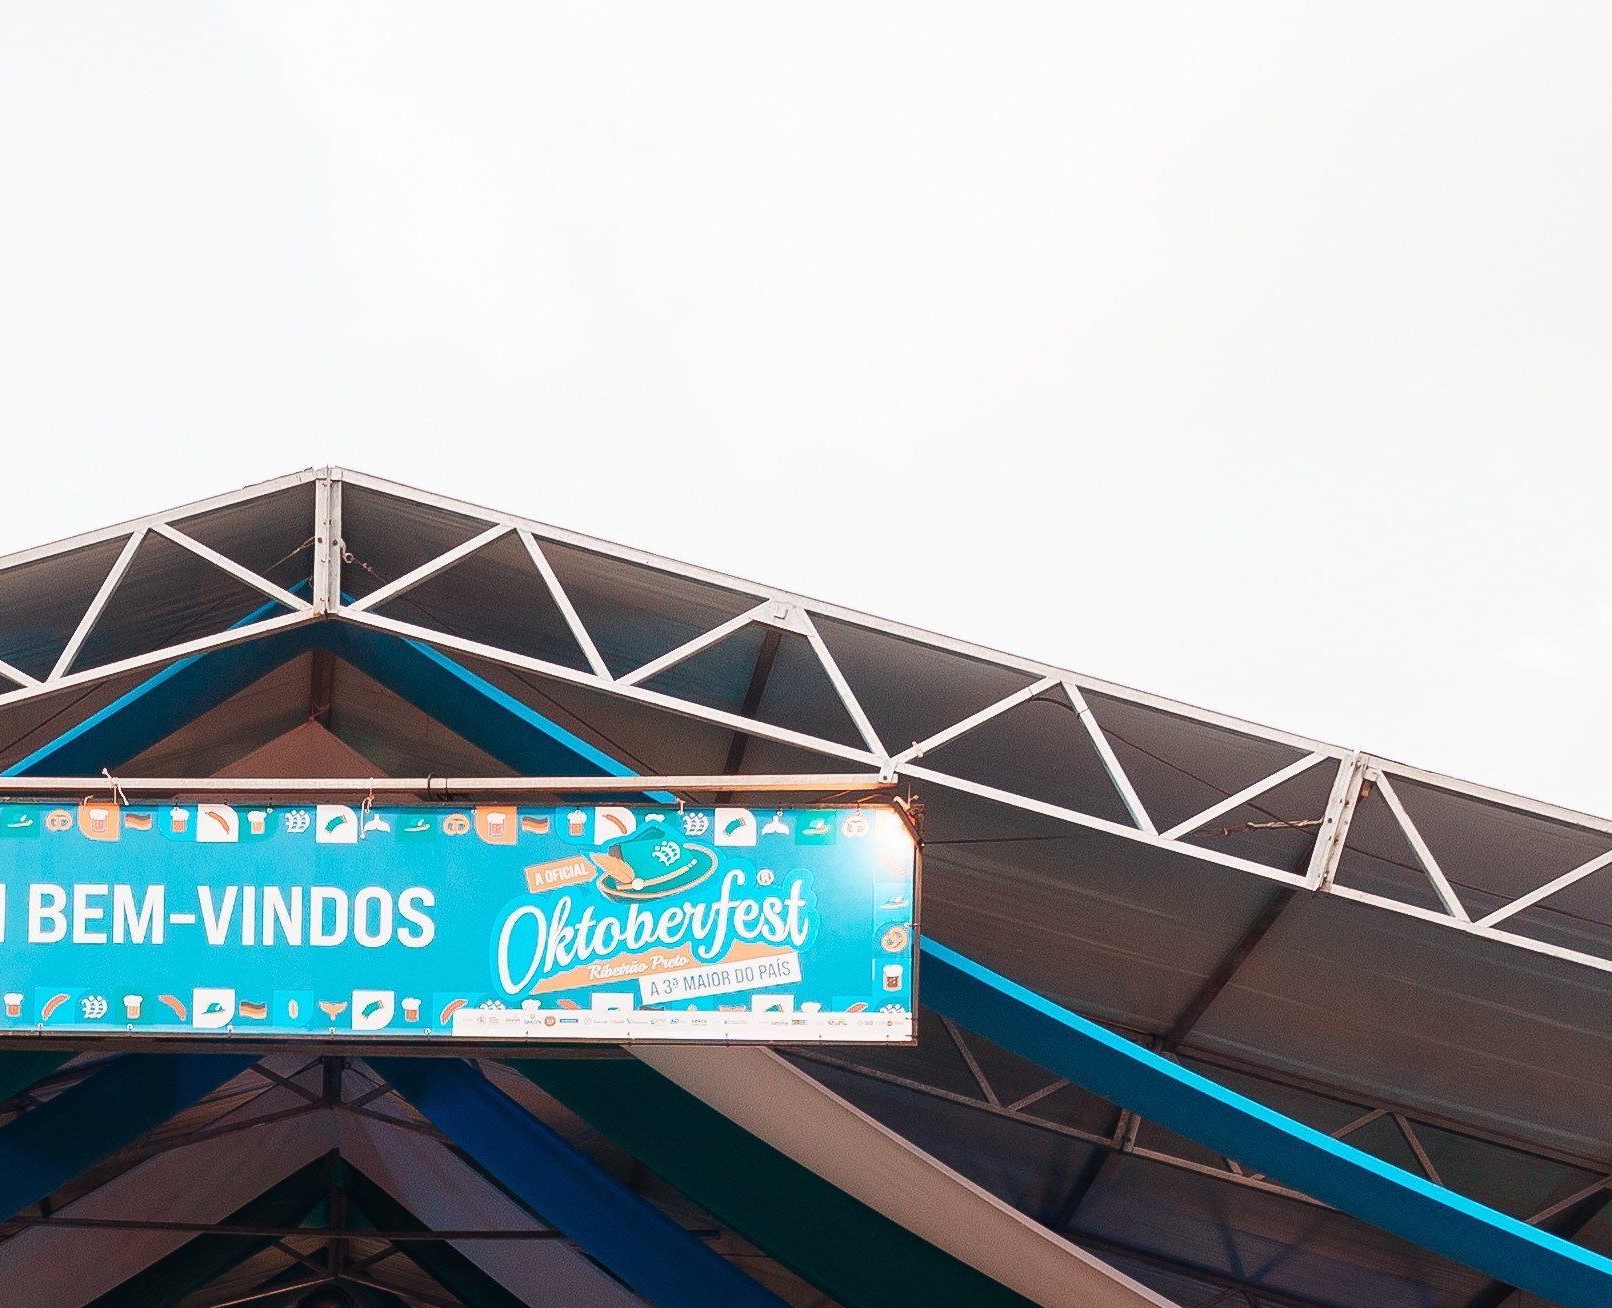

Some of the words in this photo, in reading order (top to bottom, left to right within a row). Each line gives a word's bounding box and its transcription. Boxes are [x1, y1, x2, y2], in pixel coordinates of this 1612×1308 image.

[534, 872, 544, 887] A
[545, 862, 590, 885] OFICIAL
[27, 883, 437, 949] BEM-VINDOS
[497, 868, 810, 996] Oktoberfest
[587, 960, 649, 980] Ribeirão
[650, 954, 690, 976] Preto
[649, 981, 660, 998] A
[662, 977, 680, 995] 3ª
[682, 968, 733, 992] MAIOR
[735, 967, 757, 985] DO
[759, 957, 792, 982] PAÍS
